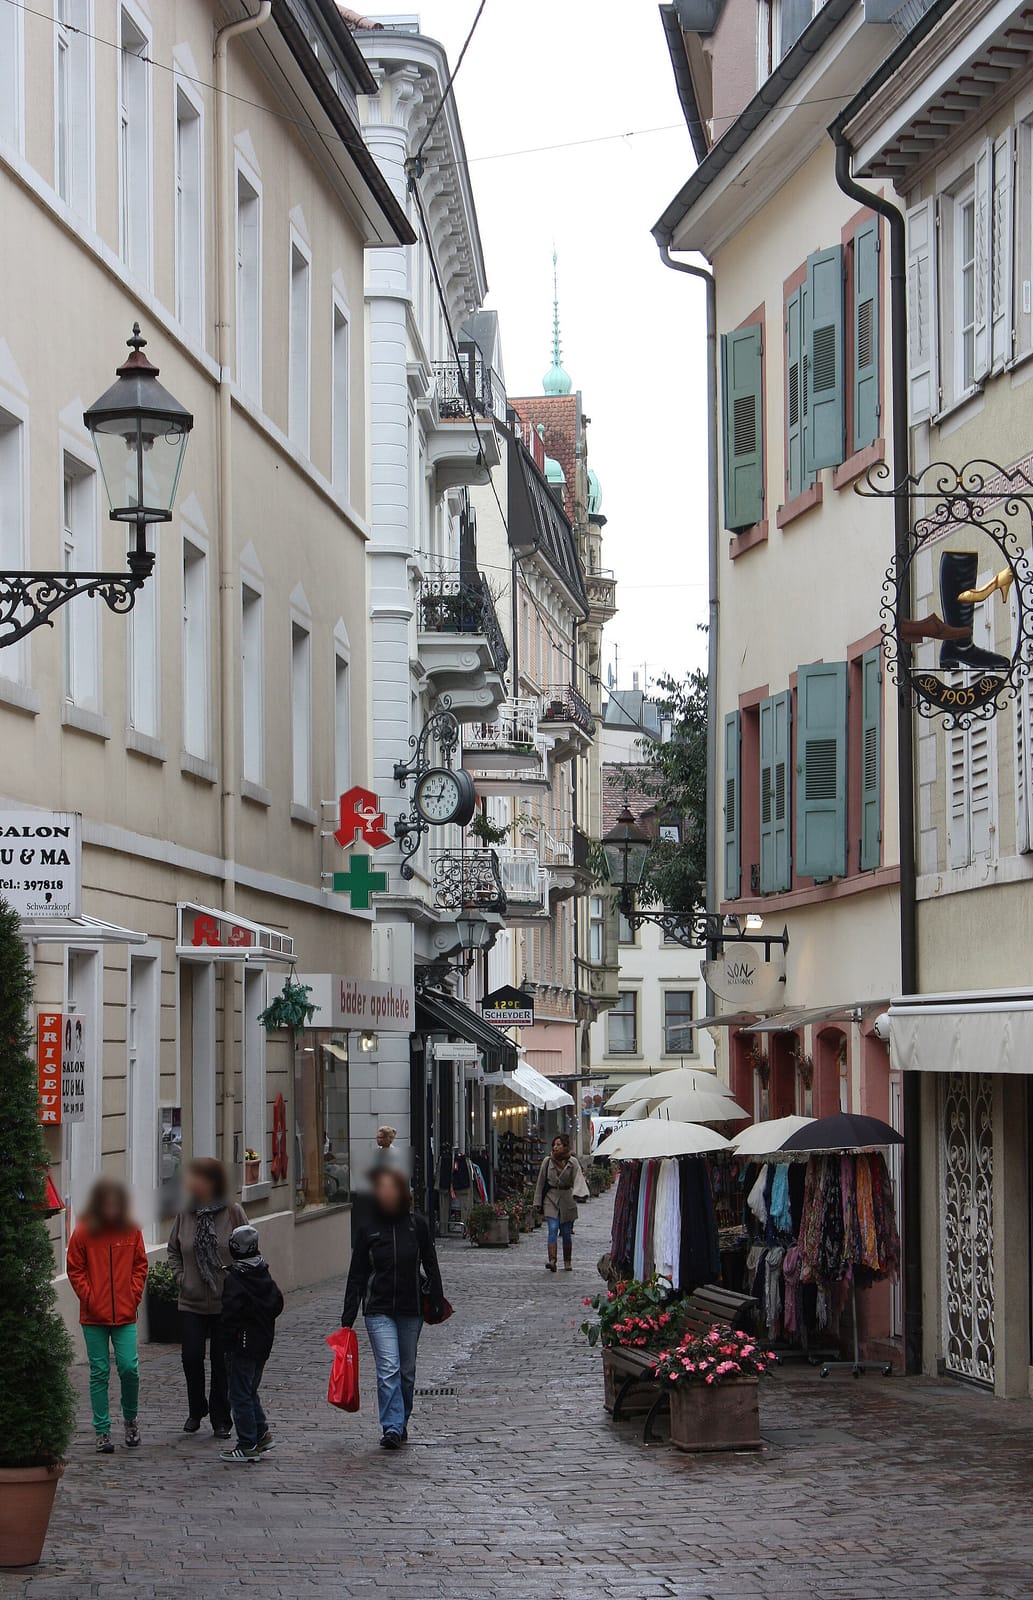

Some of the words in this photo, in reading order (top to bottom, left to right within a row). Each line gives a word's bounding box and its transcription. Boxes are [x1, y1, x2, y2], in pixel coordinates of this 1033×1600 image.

[941, 688, 976, 705] 1905
[0, 826, 71, 838] ALON
[0, 848, 14, 865] U
[20, 848, 36, 865] &
[40, 848, 71, 865] MA
[23, 880, 64, 891] 397818
[26, 902, 71, 912] Schwarzkopf
[340, 980, 367, 1015] bäder
[370, 987, 410, 1024] apotheke
[484, 1010, 531, 1019] SCHEYDER
[41, 1016, 58, 1121] FRISEUR
[62, 1061, 85, 1073] SALON
